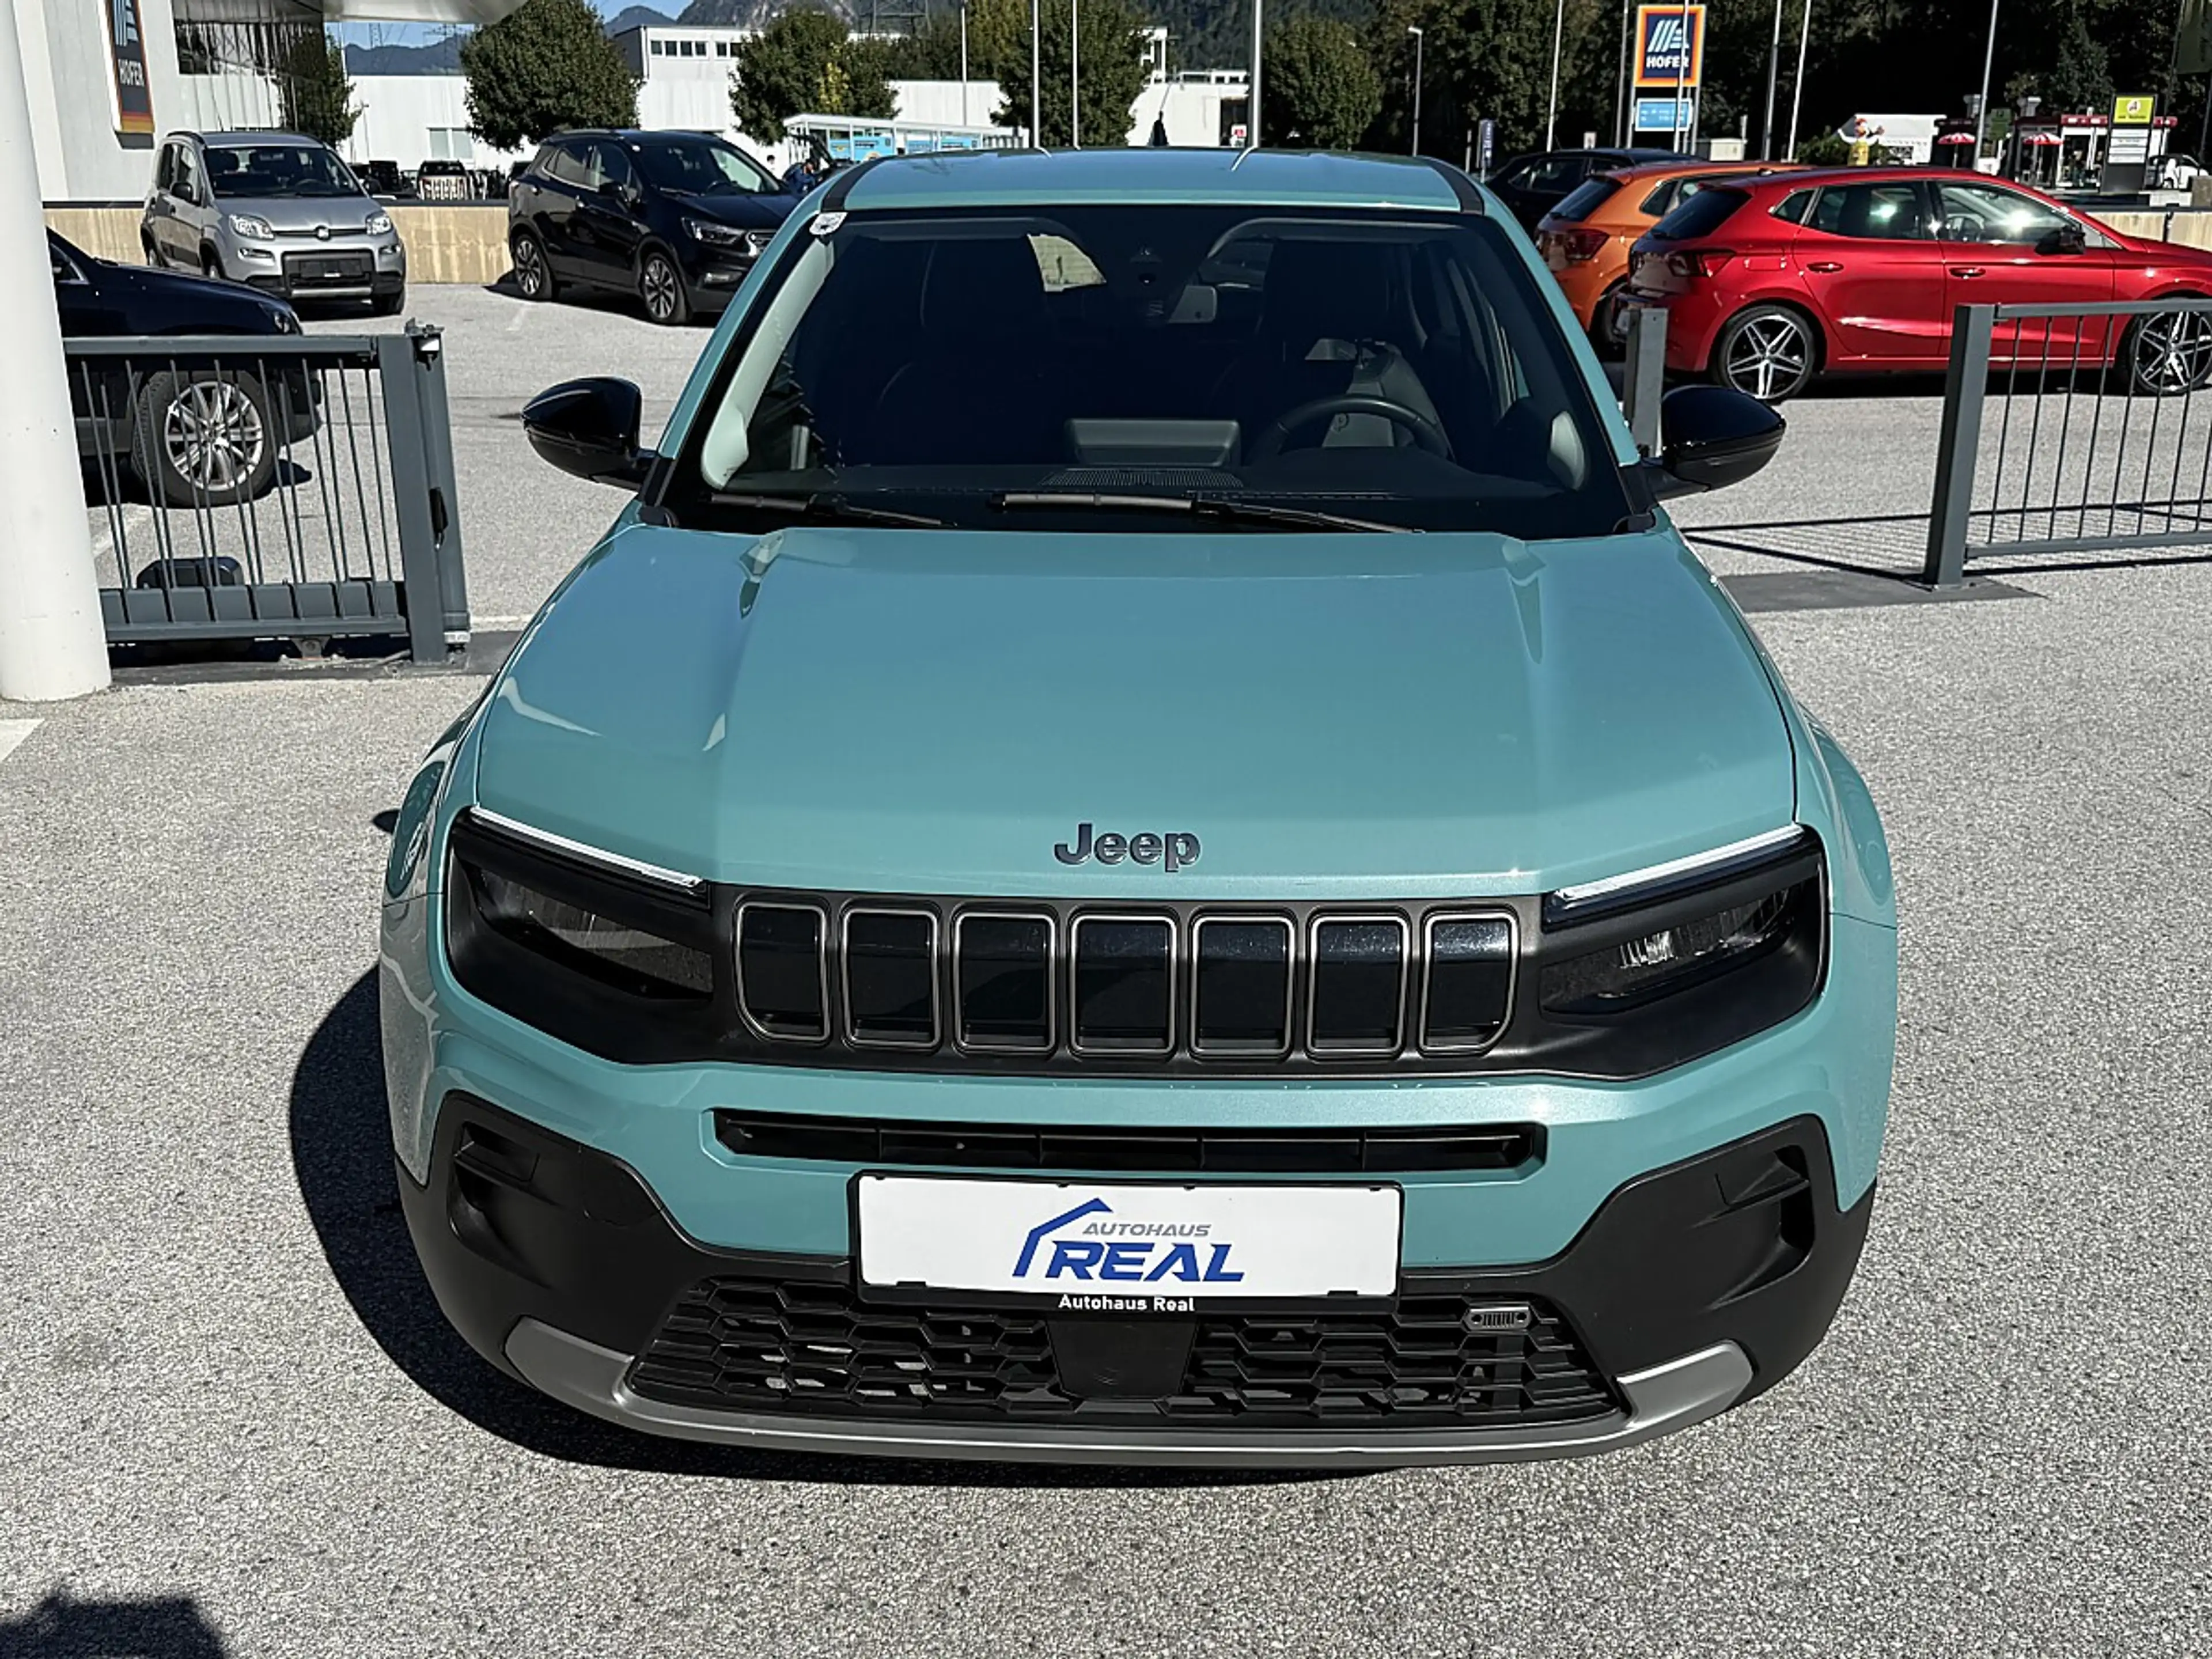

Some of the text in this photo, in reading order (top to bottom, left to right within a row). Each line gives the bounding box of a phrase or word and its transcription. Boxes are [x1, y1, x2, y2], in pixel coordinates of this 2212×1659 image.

[1646, 55, 1689, 68] HOFER
[1054, 823, 1201, 872] Jeep
[1082, 1222, 1211, 1237] AUTOHAUS
[1045, 1240, 1245, 1282] REAL
[1058, 1294, 1195, 1312] Autohaus Real
